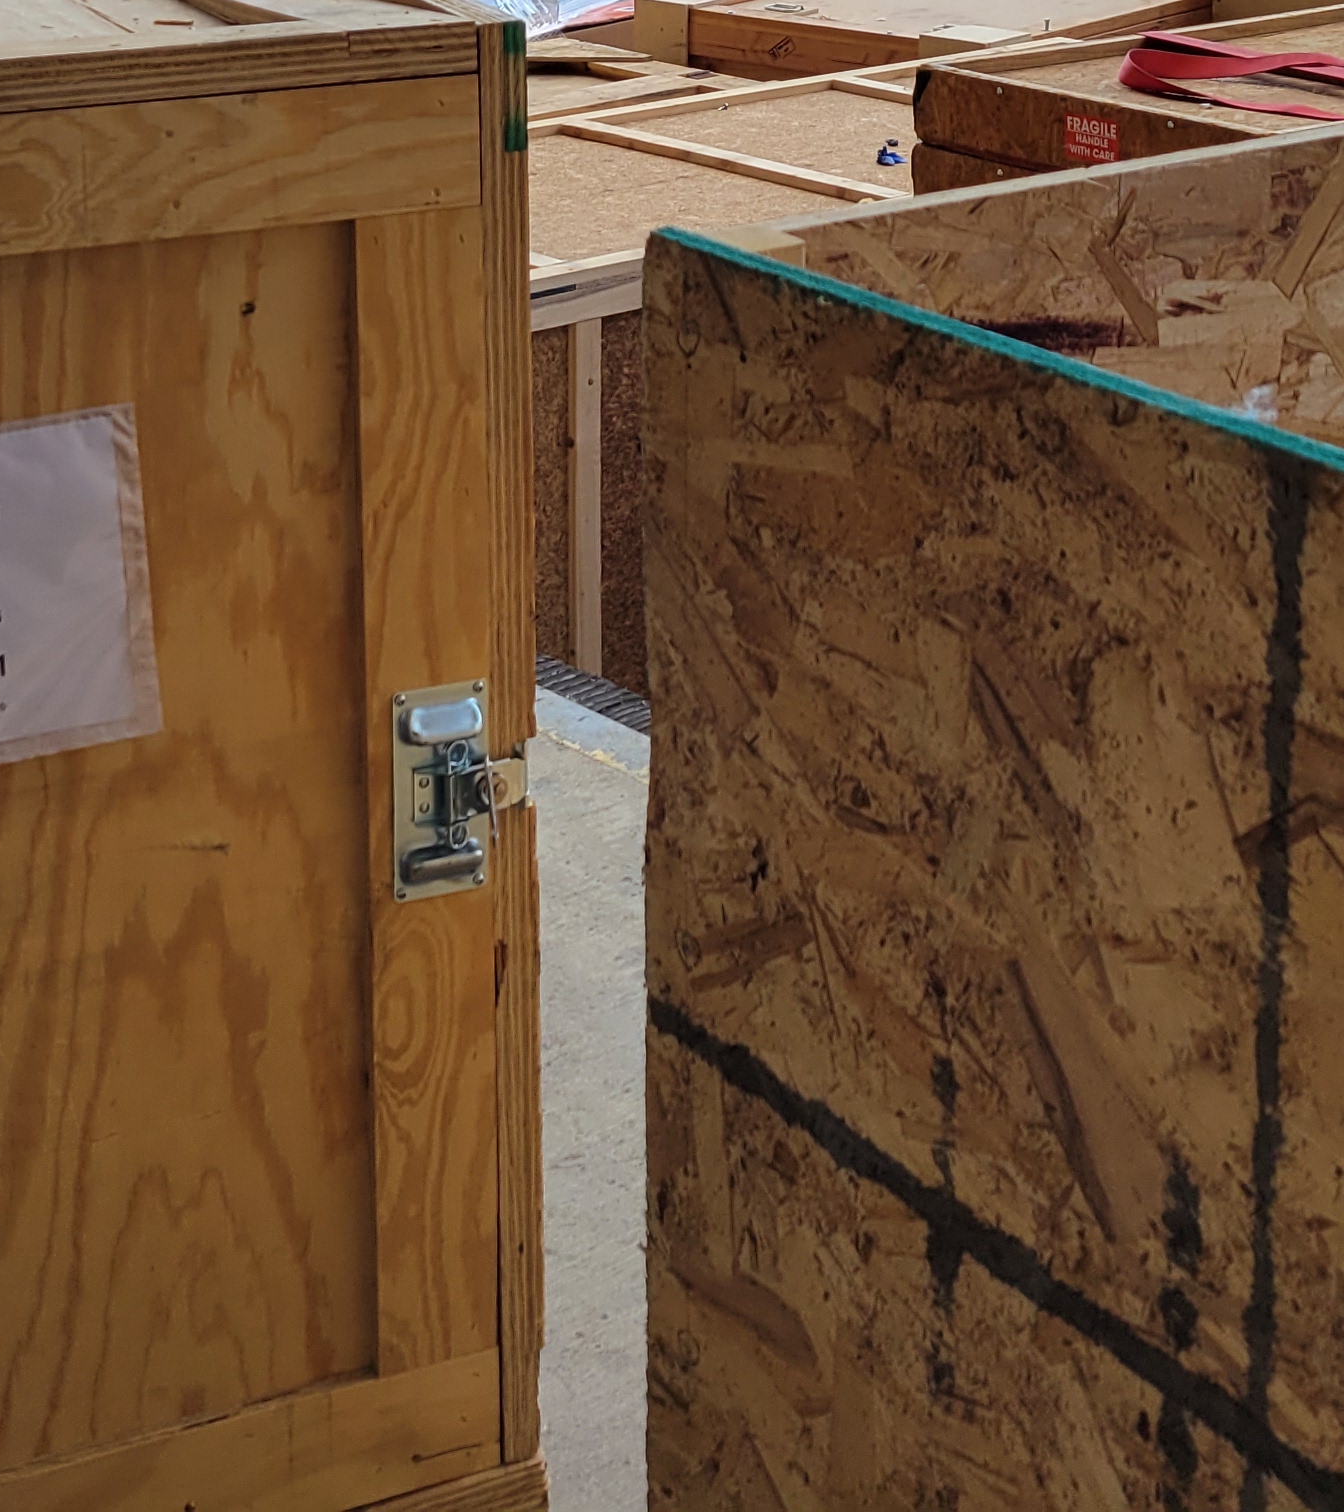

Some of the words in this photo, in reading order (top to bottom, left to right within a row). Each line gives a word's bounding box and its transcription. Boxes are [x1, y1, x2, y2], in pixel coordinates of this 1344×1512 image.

[1066, 115, 1117, 138] FRAGILE
[1075, 133, 1109, 149] HANDLE
[1069, 144, 1091, 157] WITH
[1092, 148, 1115, 161] CARE
